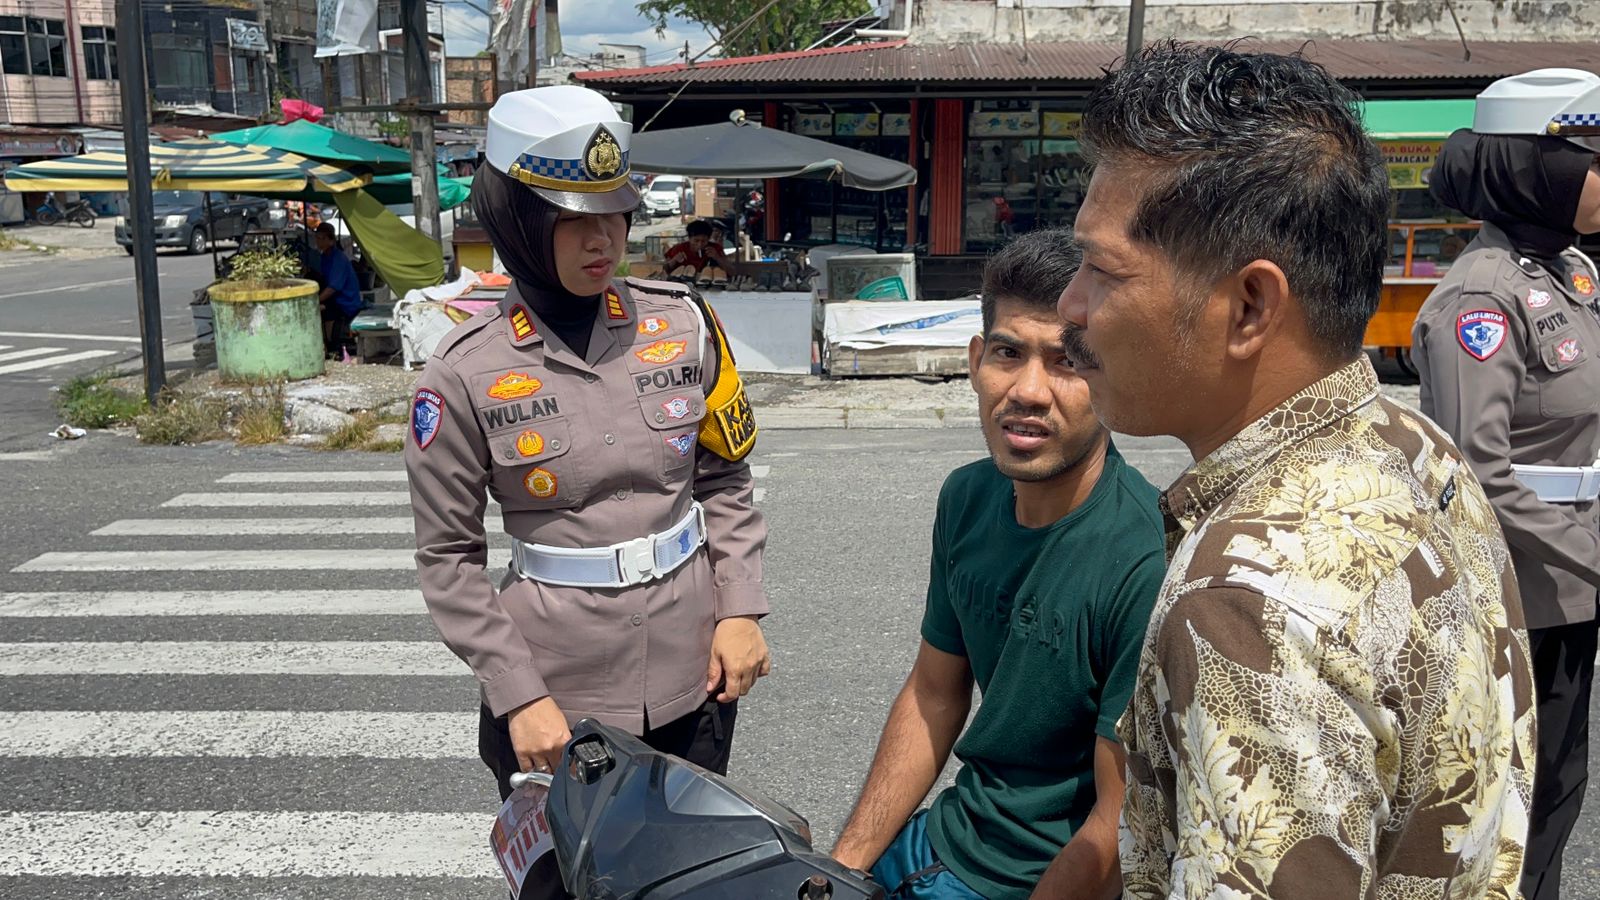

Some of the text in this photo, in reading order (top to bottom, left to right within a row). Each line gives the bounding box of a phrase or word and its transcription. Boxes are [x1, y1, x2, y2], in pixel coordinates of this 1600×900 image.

[1400, 145, 1432, 154] BUKA
[1388, 155, 1431, 164] RMACAM
[1461, 312, 1479, 323] LALU
[1536, 311, 1569, 336] PUTRI
[635, 365, 700, 393] POLRI
[483, 397, 560, 429] WULAN
